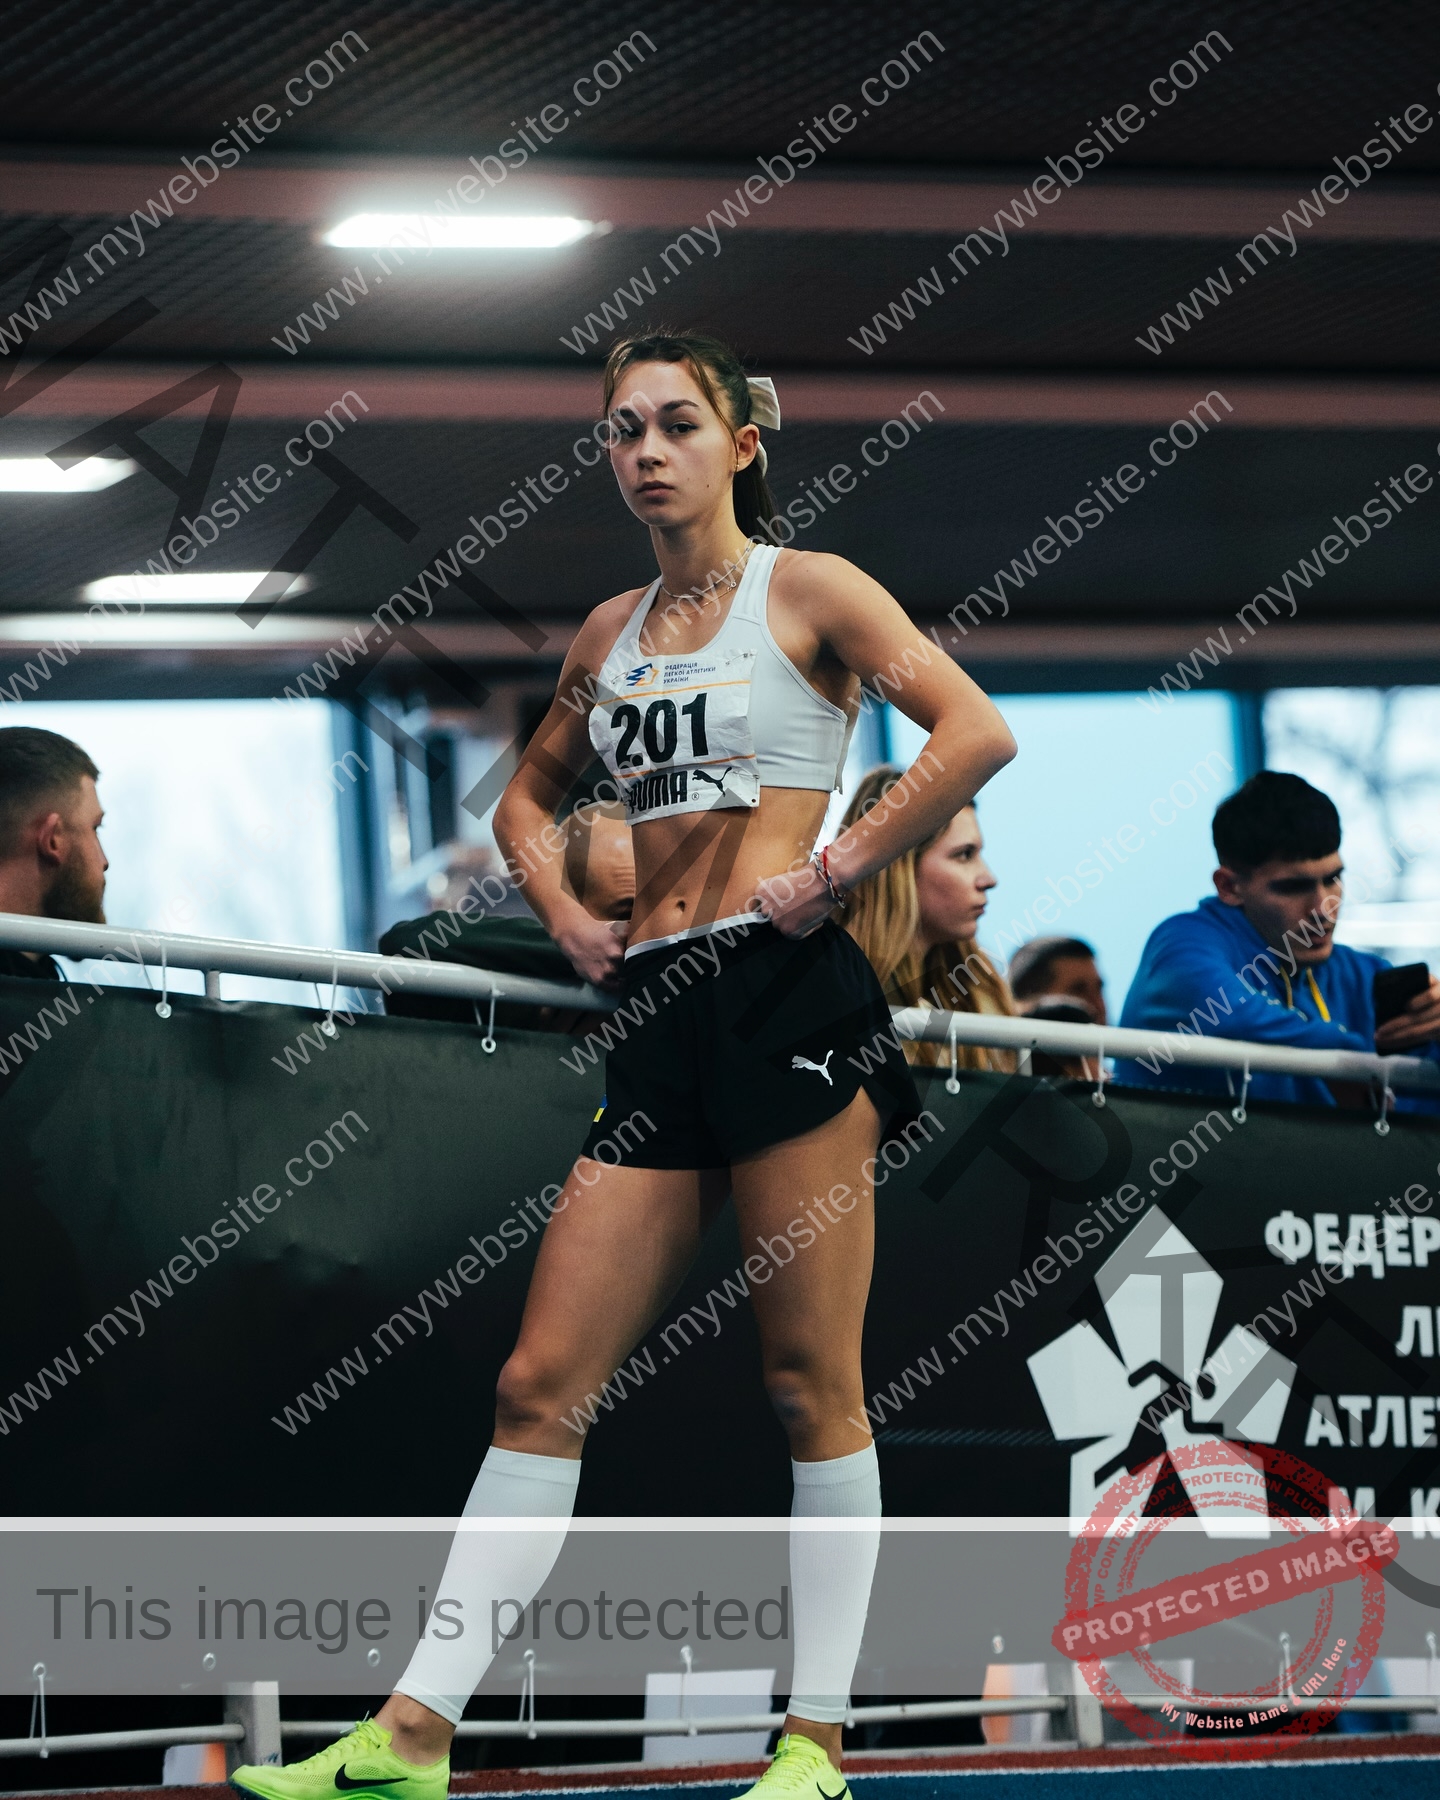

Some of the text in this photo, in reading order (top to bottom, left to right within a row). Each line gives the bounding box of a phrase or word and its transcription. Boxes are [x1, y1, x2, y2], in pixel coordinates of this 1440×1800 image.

[663, 667, 716, 678] ЛЕГКОЇ АТЛЕТИКИ
[663, 676, 689, 684] УКРАЇНИ
[664, 662, 698, 670] ФЕДЕРАЦІЯ
[610, 692, 709, 770] 201
[624, 770, 688, 815] PUMA
[1395, 1305, 1440, 1357] Л
[1304, 1394, 1440, 1448] АТЛЕ
